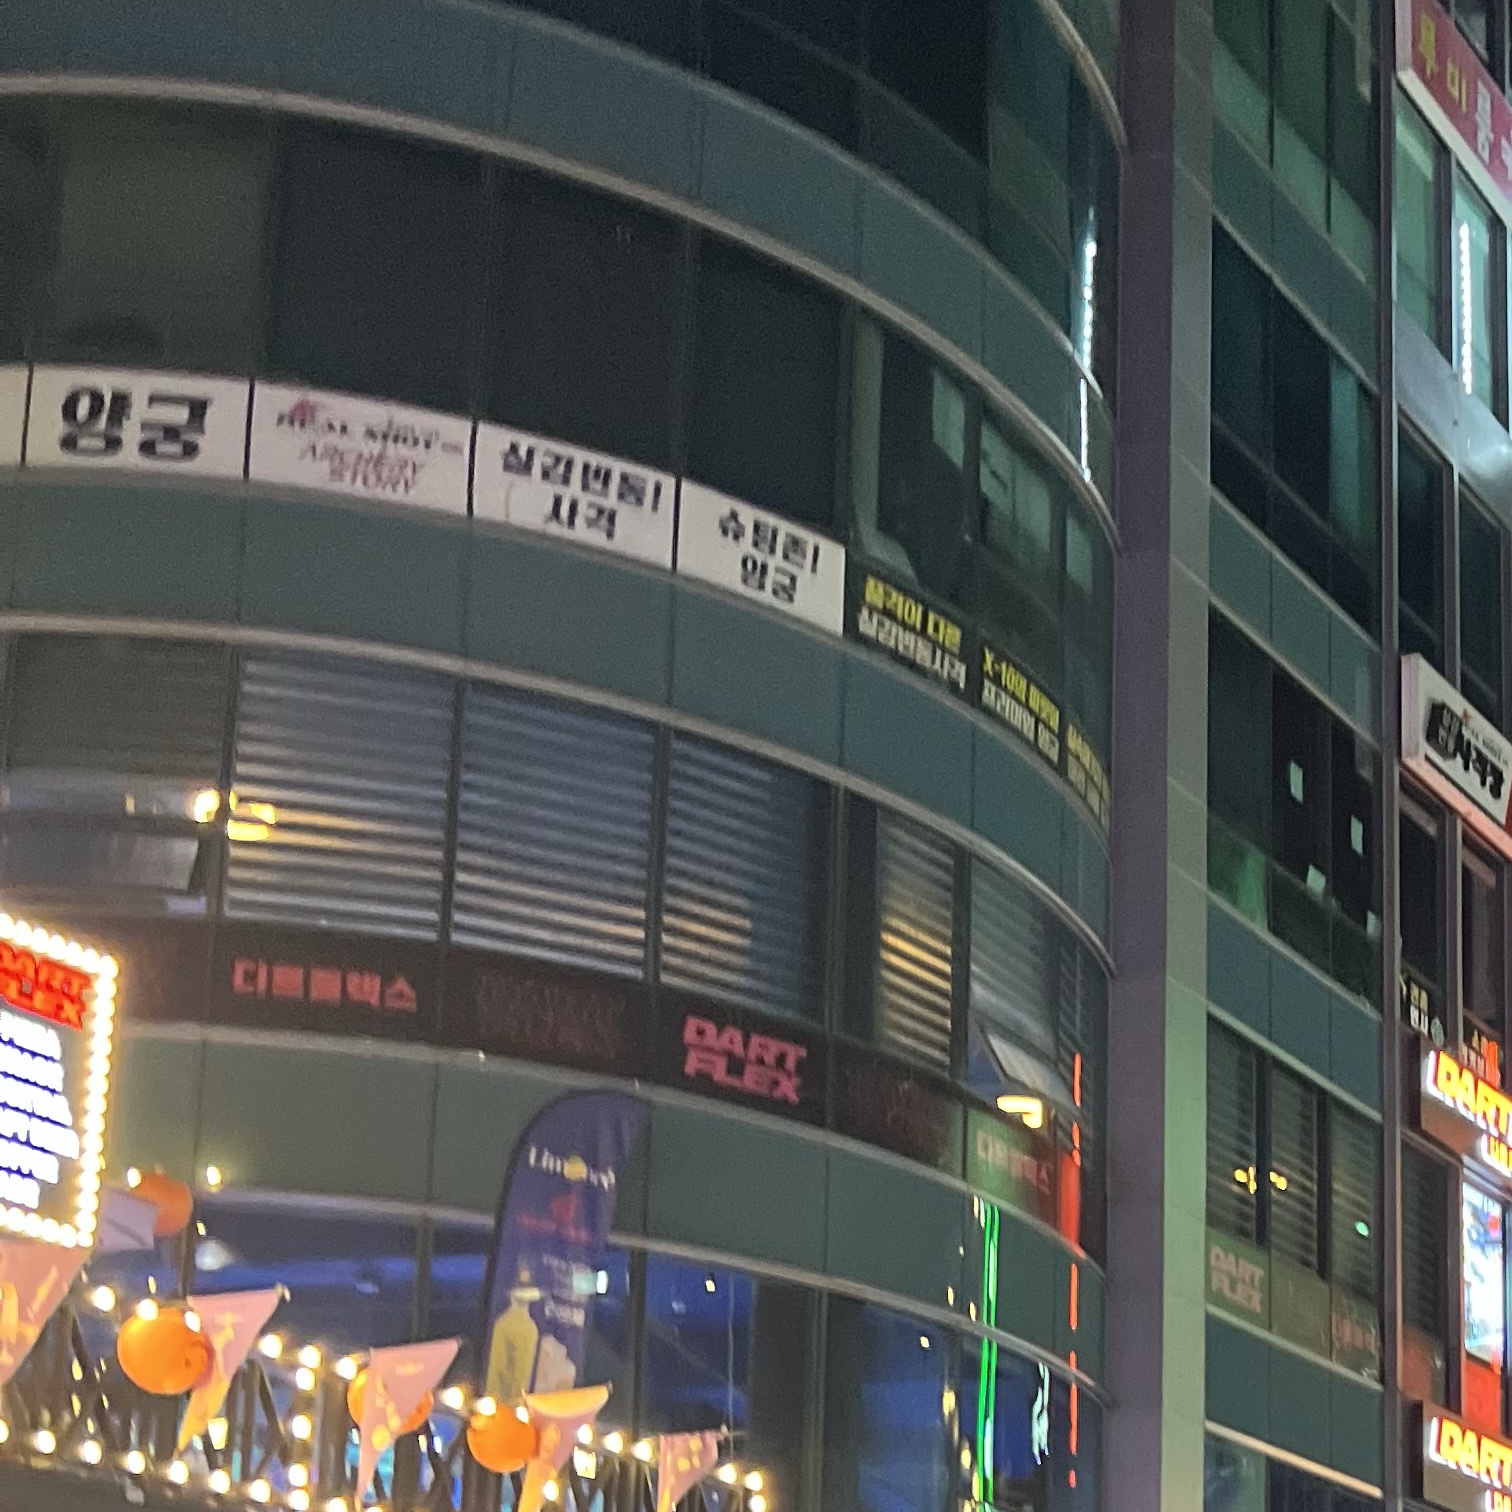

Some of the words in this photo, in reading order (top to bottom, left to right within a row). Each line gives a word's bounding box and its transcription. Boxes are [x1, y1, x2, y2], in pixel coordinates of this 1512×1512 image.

[59, 387, 214, 464] 양궁
[543, 493, 618, 543] 사격
[683, 1014, 807, 1074] DART
[684, 1049, 800, 1106] FLEX
